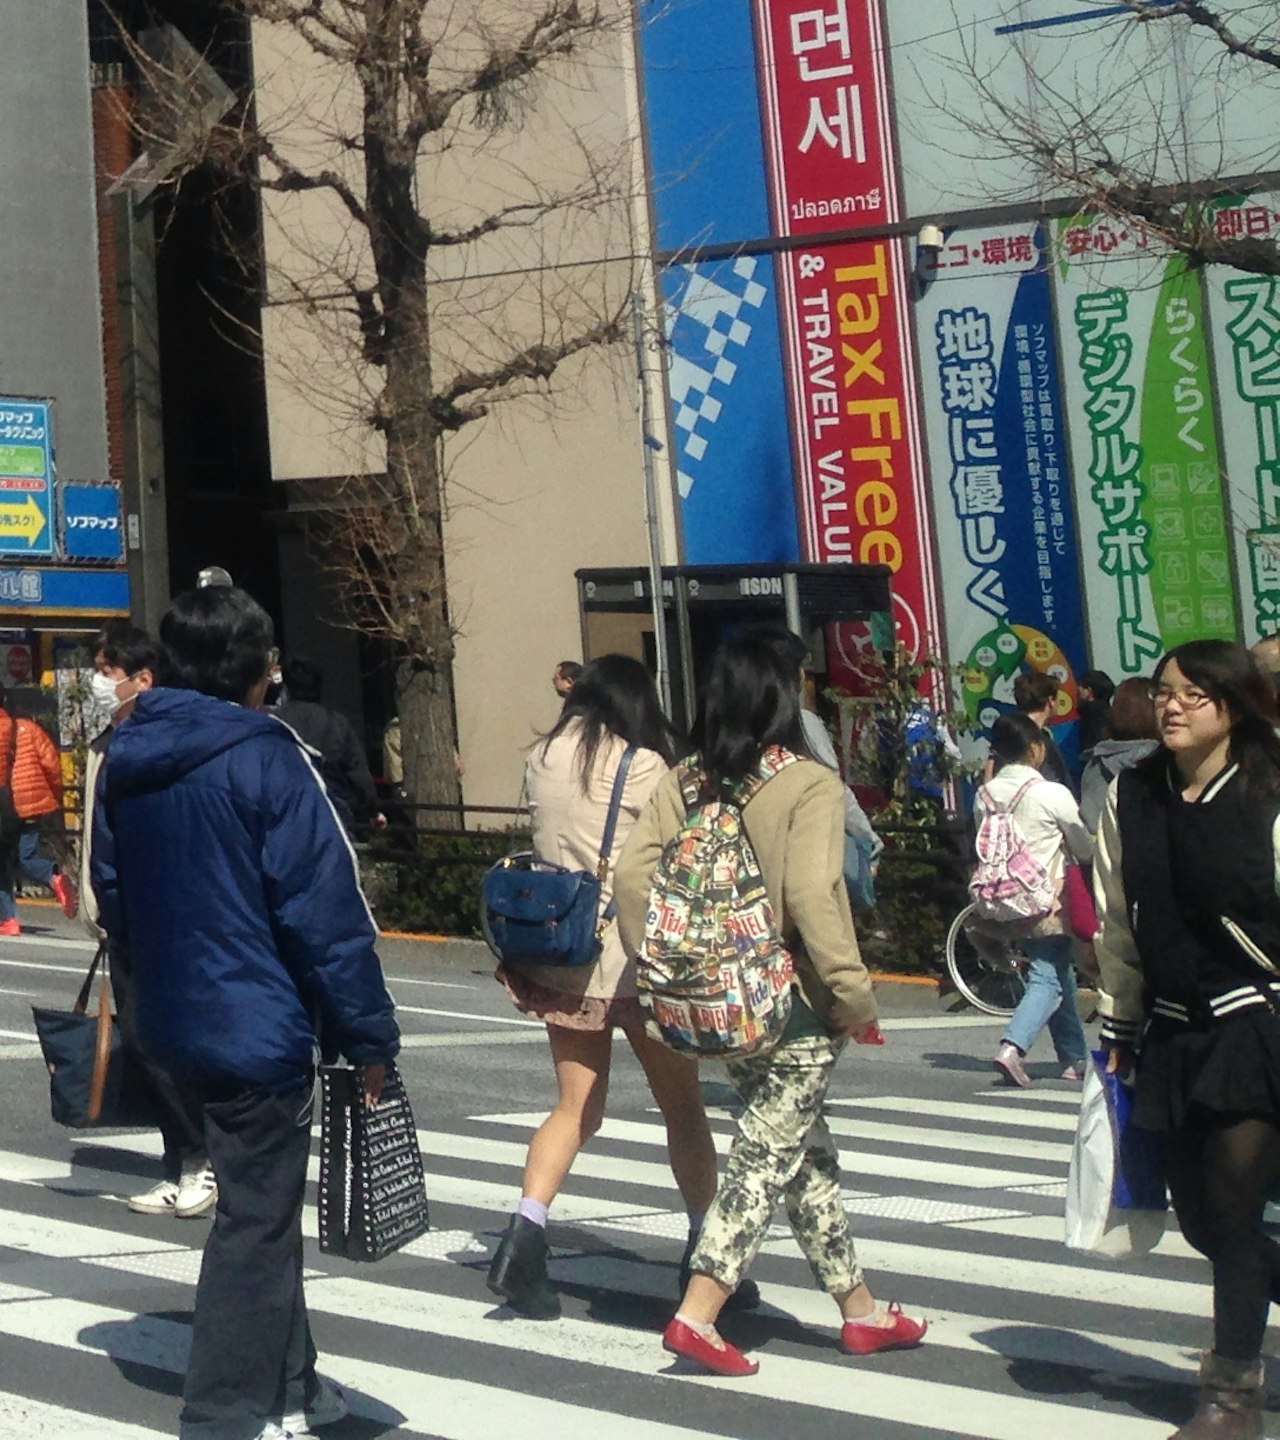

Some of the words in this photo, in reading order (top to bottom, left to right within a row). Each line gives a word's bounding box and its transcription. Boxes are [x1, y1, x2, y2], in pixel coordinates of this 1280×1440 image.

[799, 253, 824, 281] &
[834, 244, 889, 387] Tax
[799, 286, 840, 440] TRAVEL
[1163, 295, 1207, 455] らくらく
[66, 515, 119, 531] ソフマップ
[847, 398, 904, 576] Free
[937, 304, 1009, 619] 地球に優しく
[1077, 288, 1163, 670] デジタルサポート
[661, 902, 688, 937] Tide
